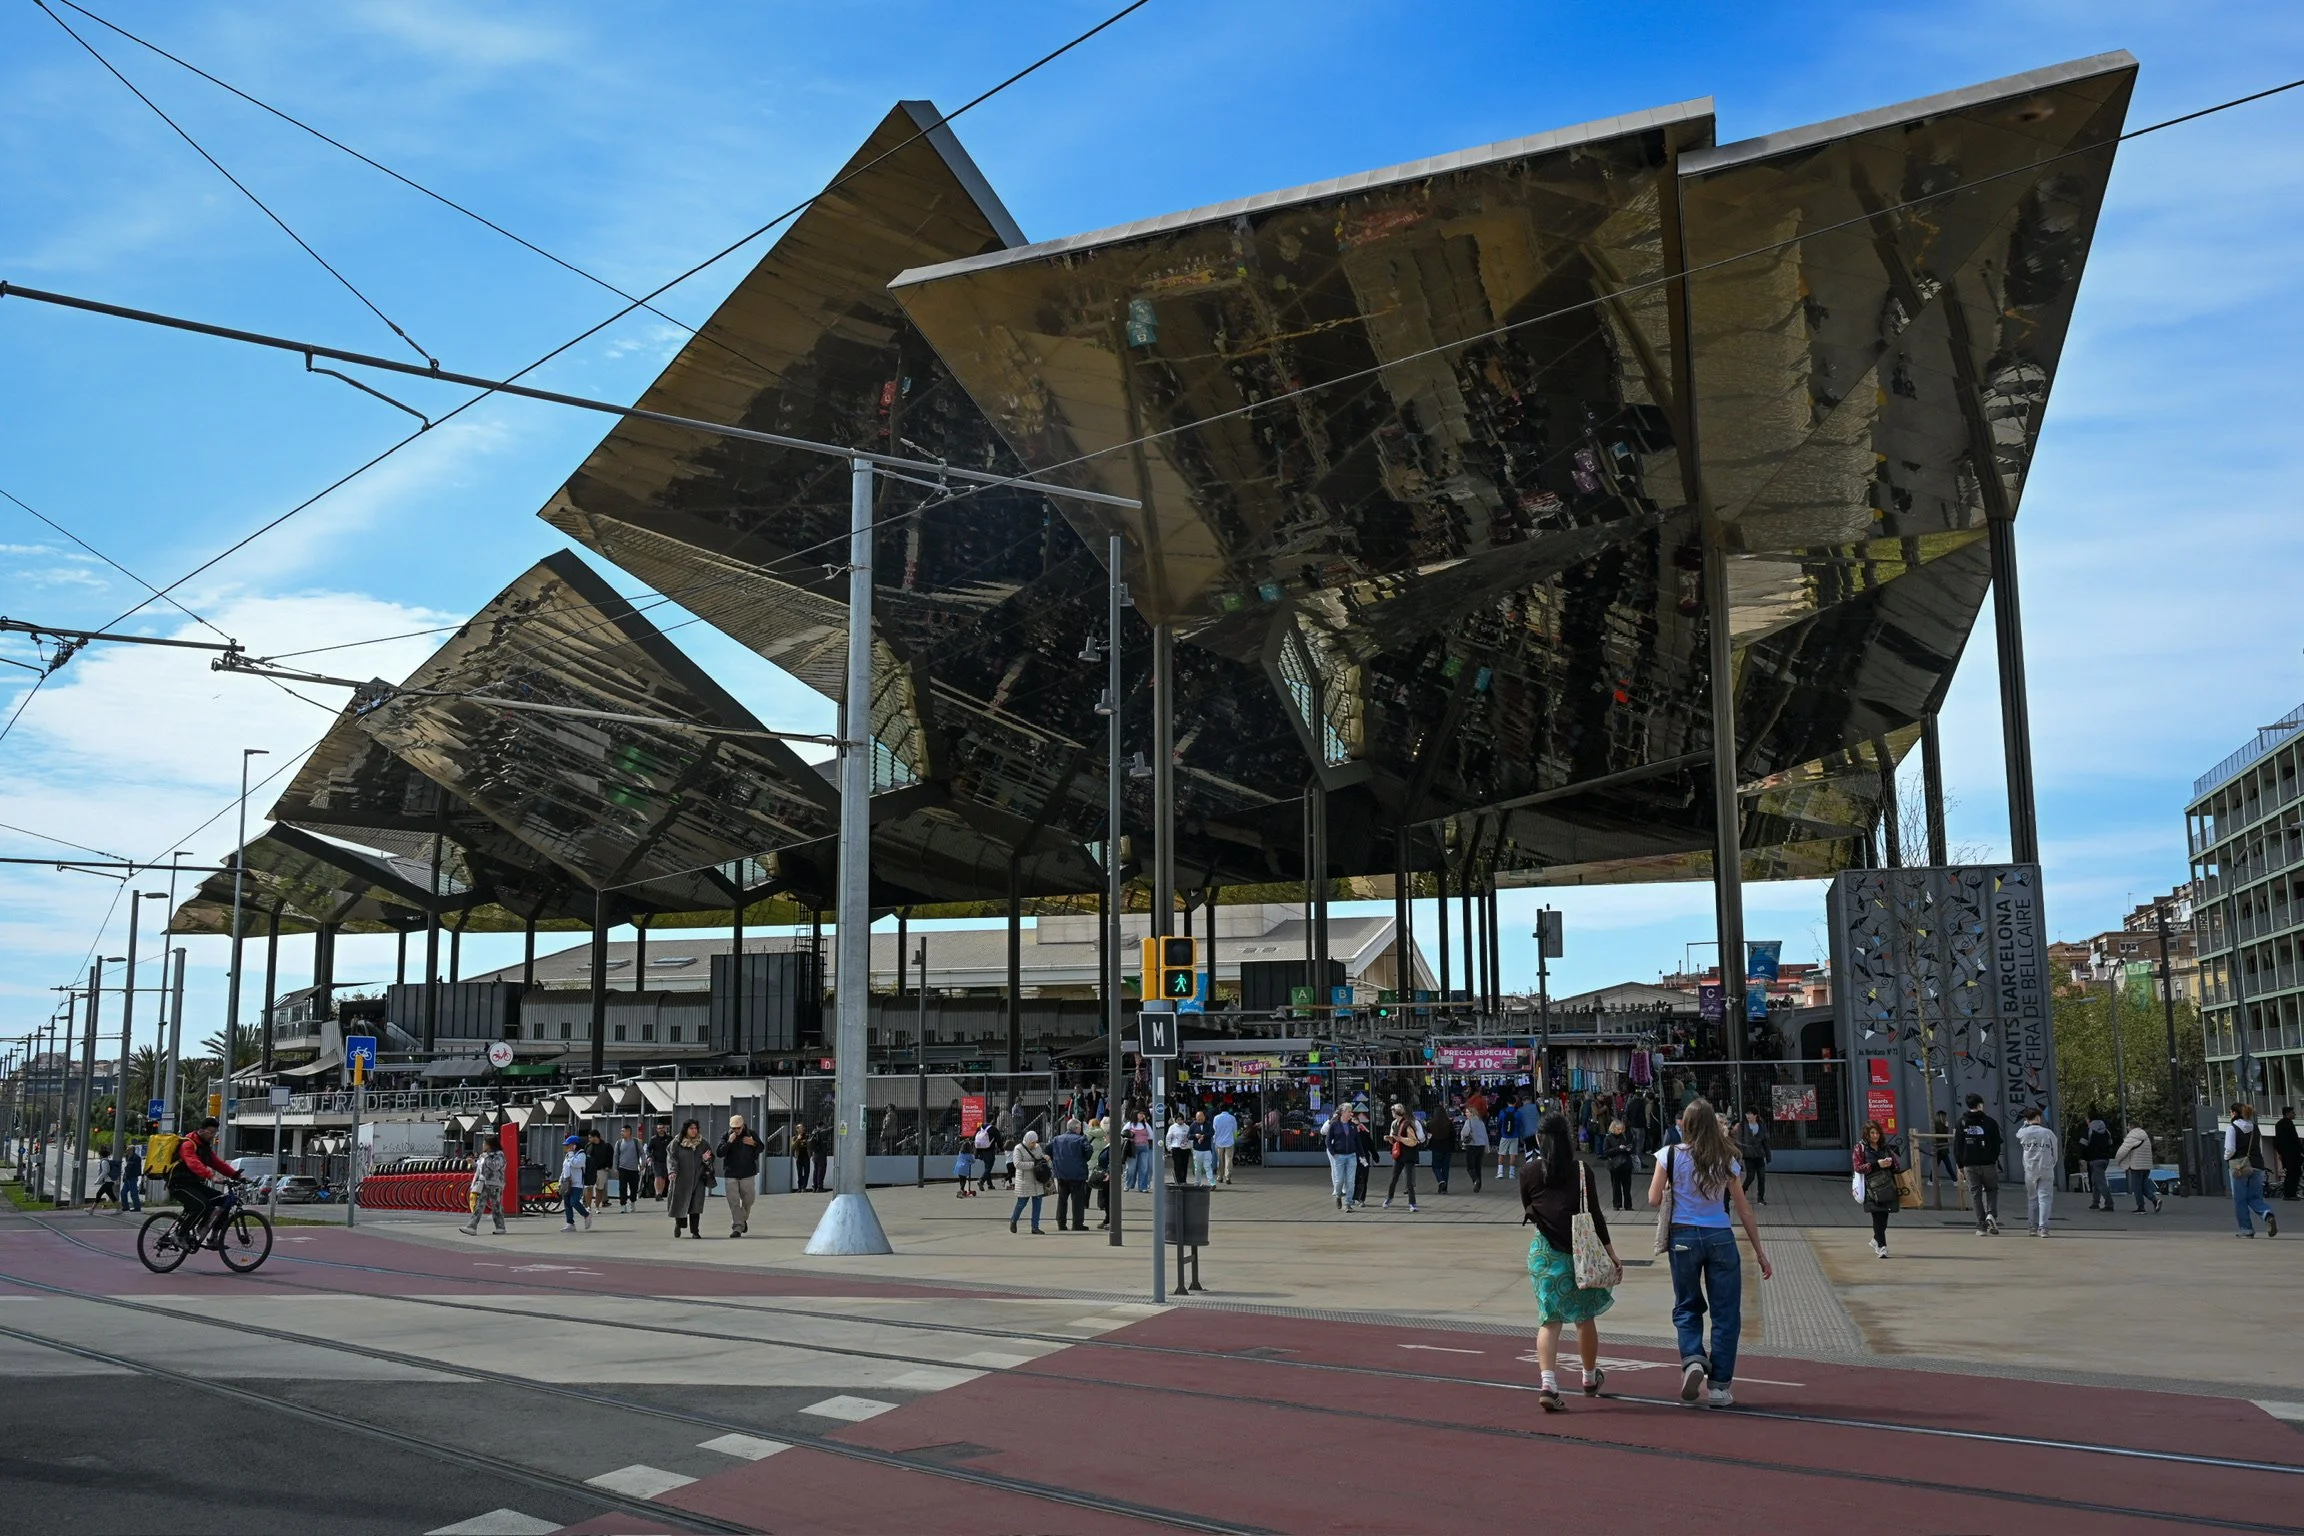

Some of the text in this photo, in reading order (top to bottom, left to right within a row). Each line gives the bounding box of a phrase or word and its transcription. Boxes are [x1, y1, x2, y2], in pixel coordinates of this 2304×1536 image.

[2015, 898, 2042, 1061] FIRA DE BELLCAIRE
[1299, 990, 1307, 999] A
[1339, 989, 1347, 999] B
[1706, 988, 1715, 999] C
[1995, 898, 2026, 1106] ENCANTS BARCELONA
[1152, 1022, 1165, 1047] M
[824, 1061, 831, 1070] D
[1458, 1058, 1466, 1069] 5
[1479, 1058, 1500, 1069] 10€
[366, 1094, 390, 1111] DE
[395, 1090, 492, 1110] BELLCAIRE
